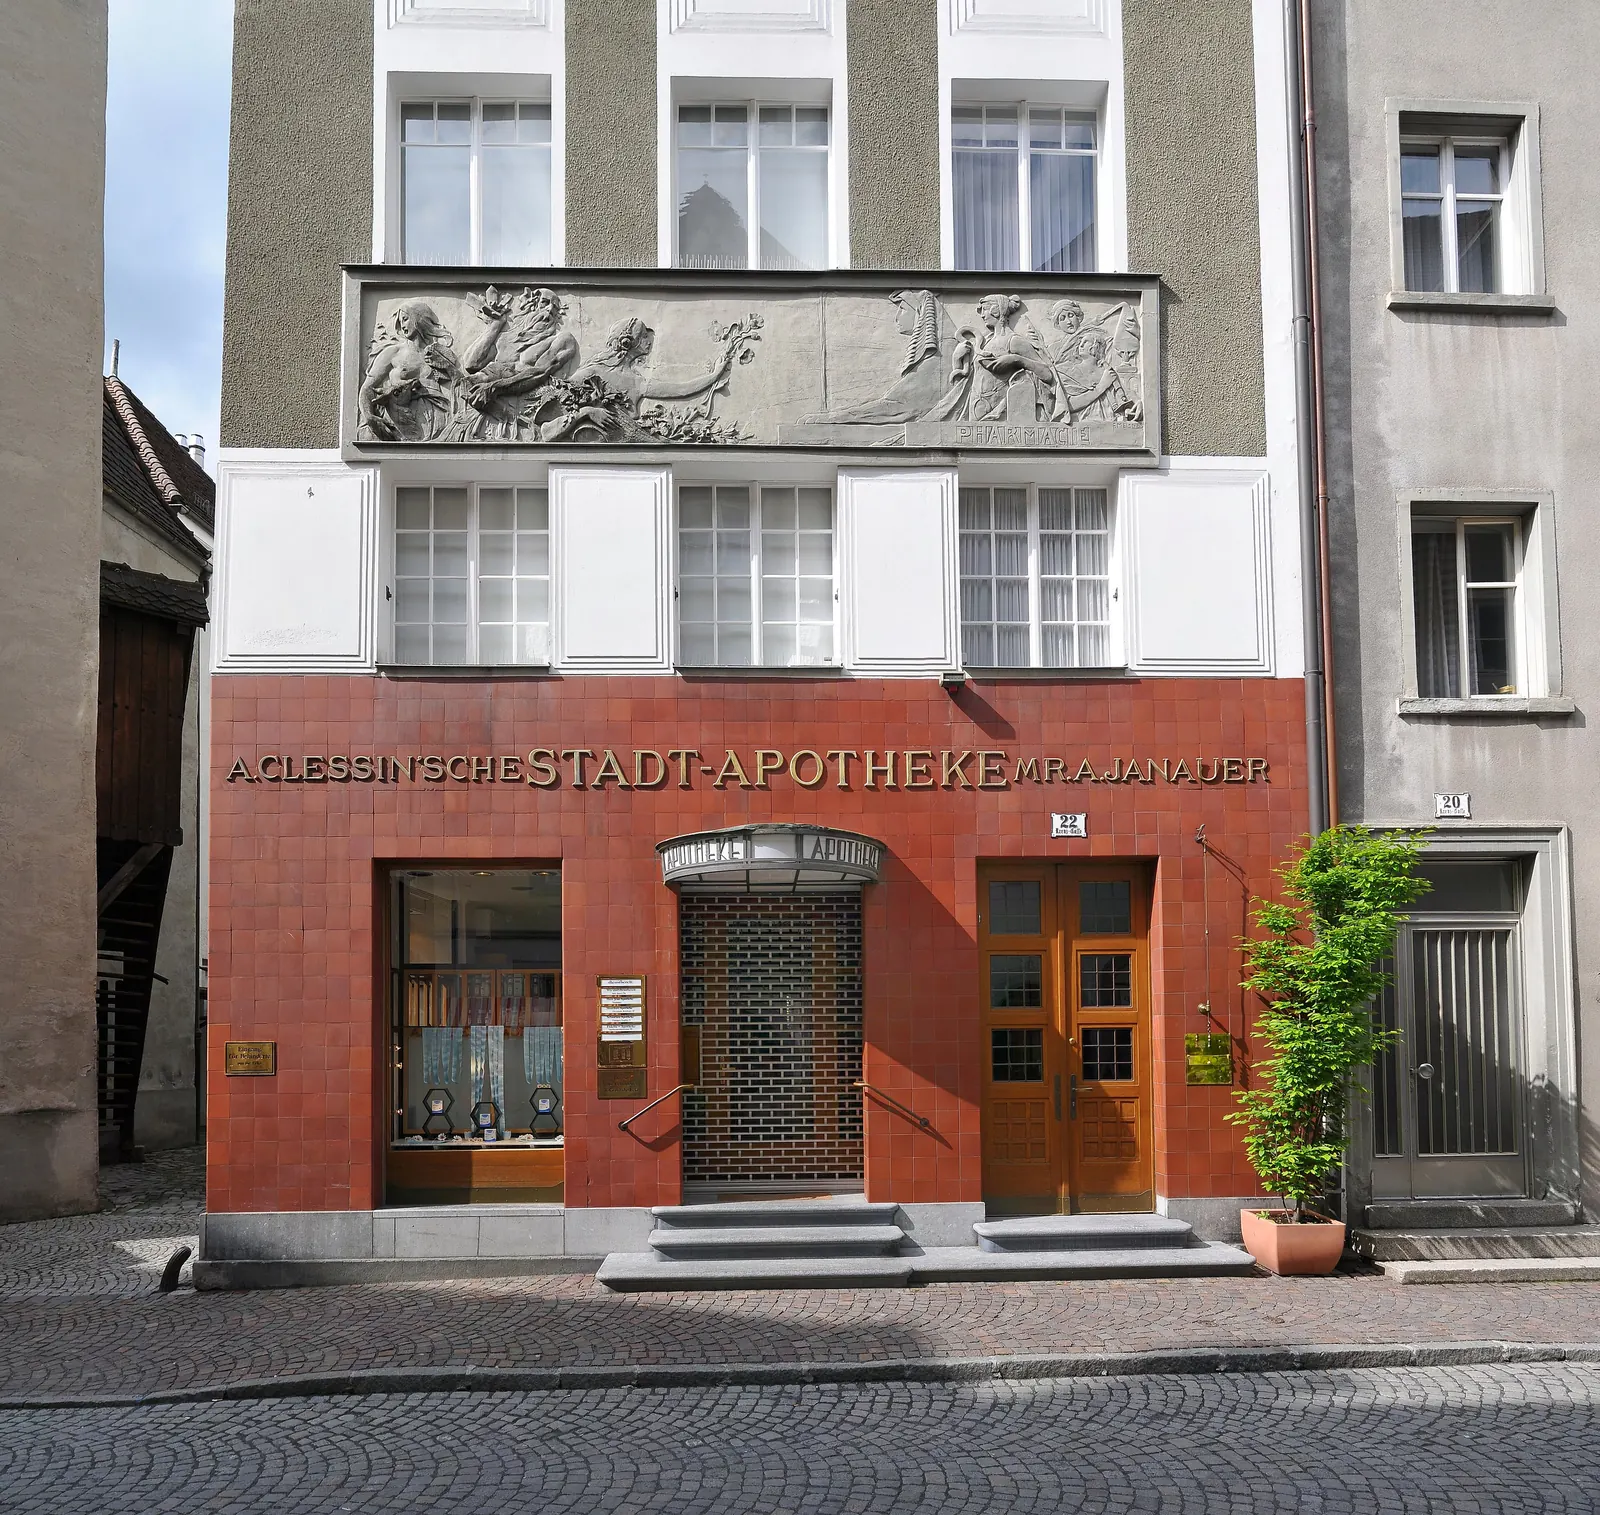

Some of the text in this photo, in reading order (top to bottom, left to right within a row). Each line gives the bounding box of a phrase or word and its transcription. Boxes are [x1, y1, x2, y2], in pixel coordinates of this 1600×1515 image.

[956, 425, 1091, 446] PHARMACIE
[526, 748, 1007, 787] STADT-APOTHEKE
[1442, 795, 1461, 809] 20
[1060, 814, 1079, 829] 22
[667, 836, 741, 869] APOTHEKE
[811, 836, 880, 869] APOTHEKE
